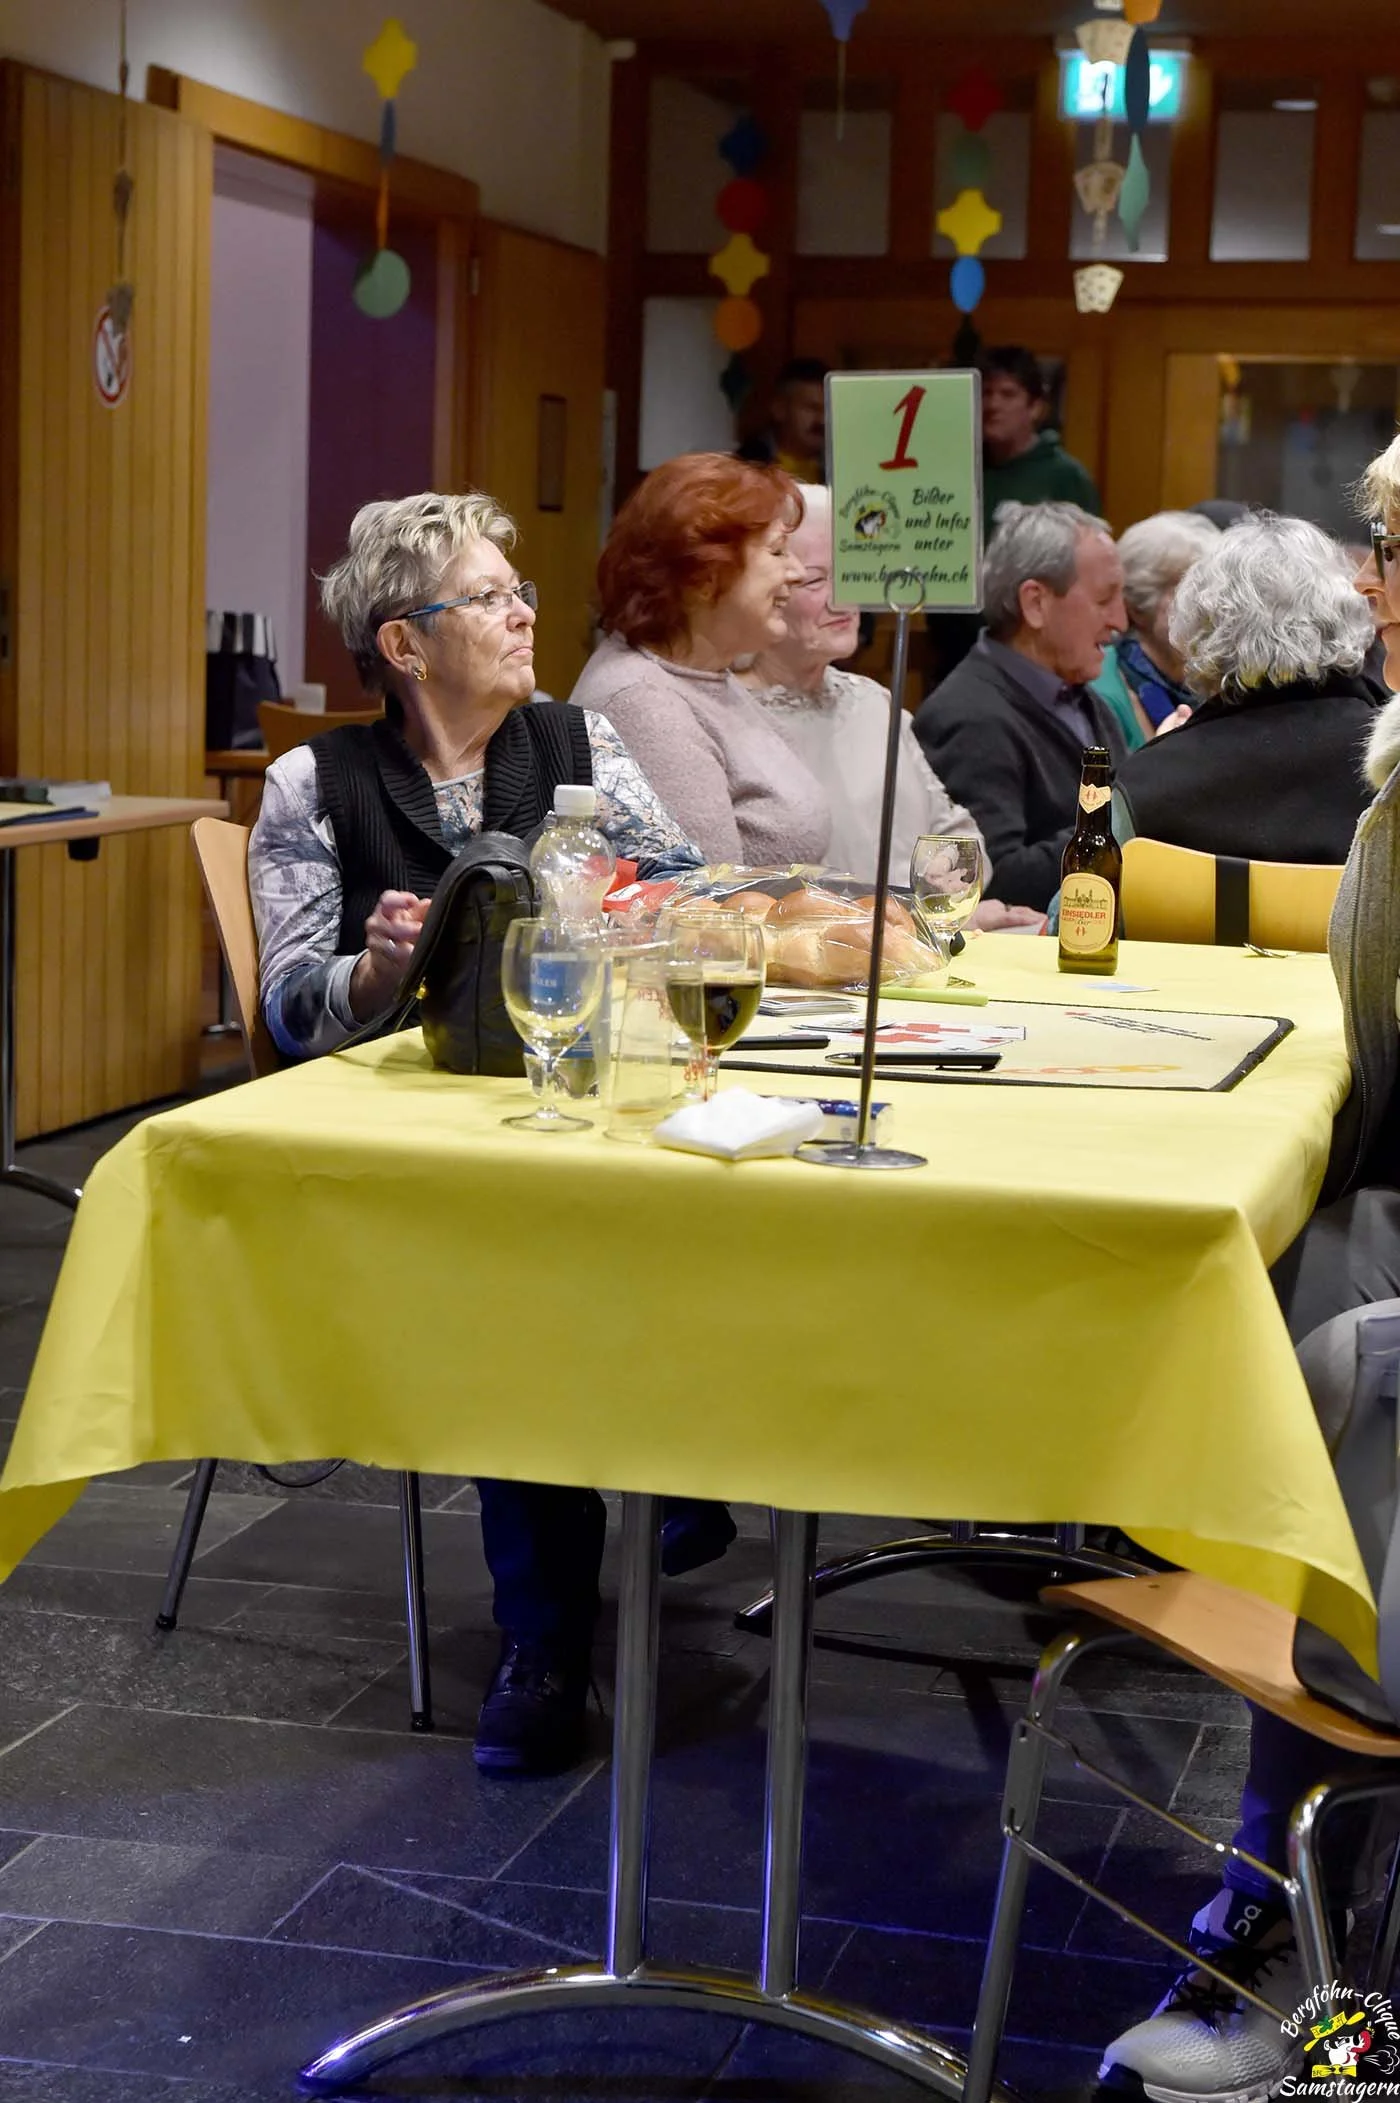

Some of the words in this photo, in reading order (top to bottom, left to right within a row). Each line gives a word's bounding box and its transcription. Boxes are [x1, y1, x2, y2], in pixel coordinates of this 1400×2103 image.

[879, 385, 927, 470] 1
[912, 486, 955, 506] Bilder
[905, 511, 931, 529] und
[935, 512, 971, 533] Infos
[914, 537, 954, 551] unter
